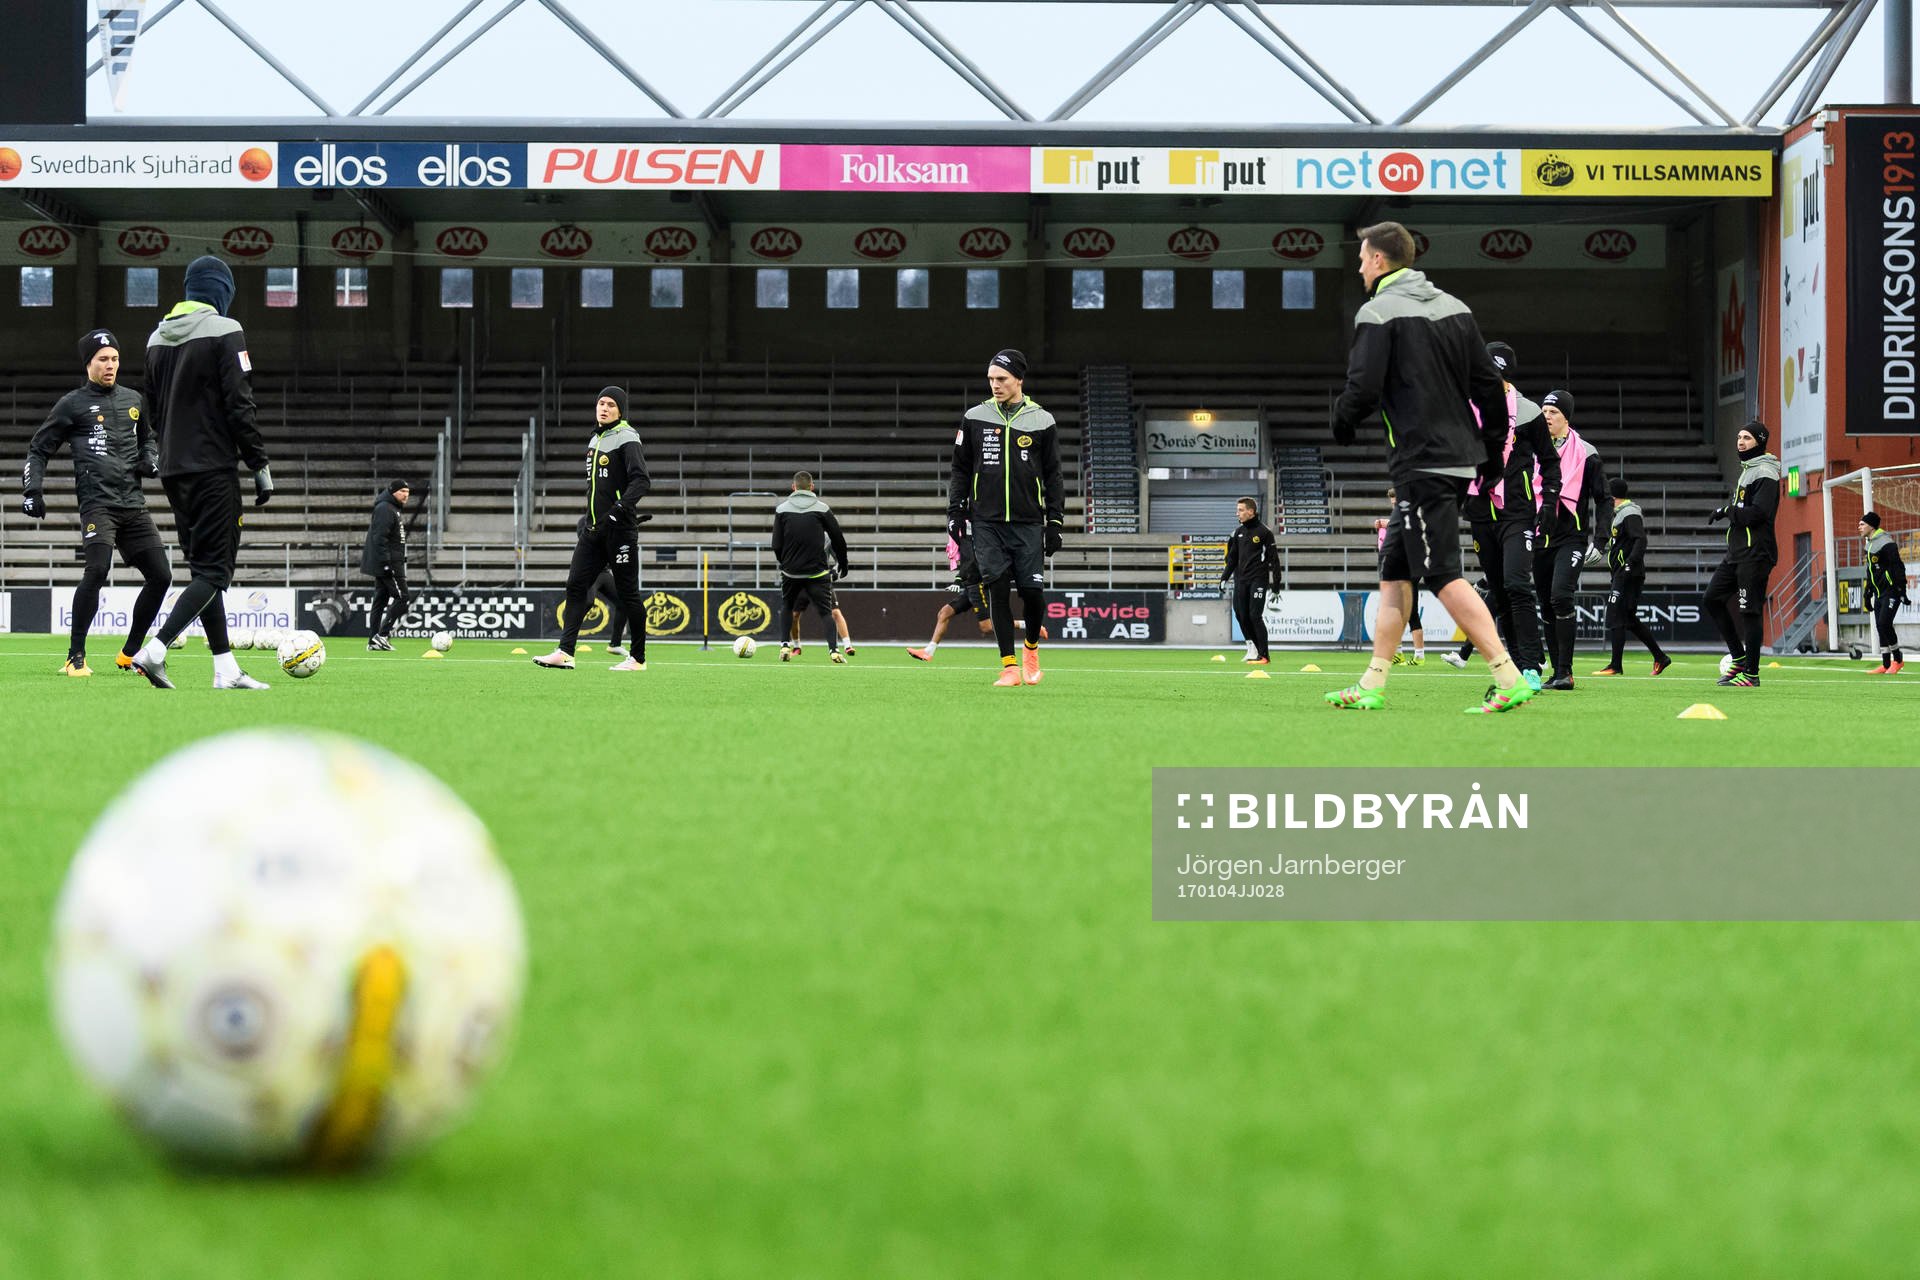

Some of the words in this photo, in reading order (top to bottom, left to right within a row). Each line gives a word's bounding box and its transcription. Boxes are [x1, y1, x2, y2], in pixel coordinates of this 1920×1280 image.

[30, 155, 137, 174] Swedbank
[143, 155, 233, 179] Sjuhärad
[294, 143, 388, 186] ellos
[417, 144, 512, 187] ellos
[543, 148, 765, 185] PULSEN
[840, 153, 969, 184] Folksam
[1586, 165, 1604, 181] VI
[1612, 164, 1762, 181] TILLSAMMANS
[23, 231, 66, 249] AXA
[122, 231, 165, 249] AXA
[227, 231, 270, 249] AXA
[336, 231, 379, 249] AXA
[441, 231, 484, 249] AXA
[545, 231, 588, 249] AXA
[650, 231, 693, 249] AXA
[755, 231, 798, 249] AXA
[859, 232, 902, 250] AXA
[964, 232, 1007, 250] AXA
[1068, 232, 1111, 250] AXA
[1172, 232, 1215, 250] AXA
[1277, 232, 1320, 250] AXA
[1486, 233, 1529, 251] AXA
[1589, 233, 1632, 251] AXA
[1197, 432, 1257, 451] Tidning
[616, 554, 629, 563] 22
[60, 607, 127, 627] laina
[1047, 602, 1150, 619] Service
[226, 612, 289, 628] amina
[1109, 623, 1150, 639] AB
[1269, 626, 1334, 635] drottsförbund
